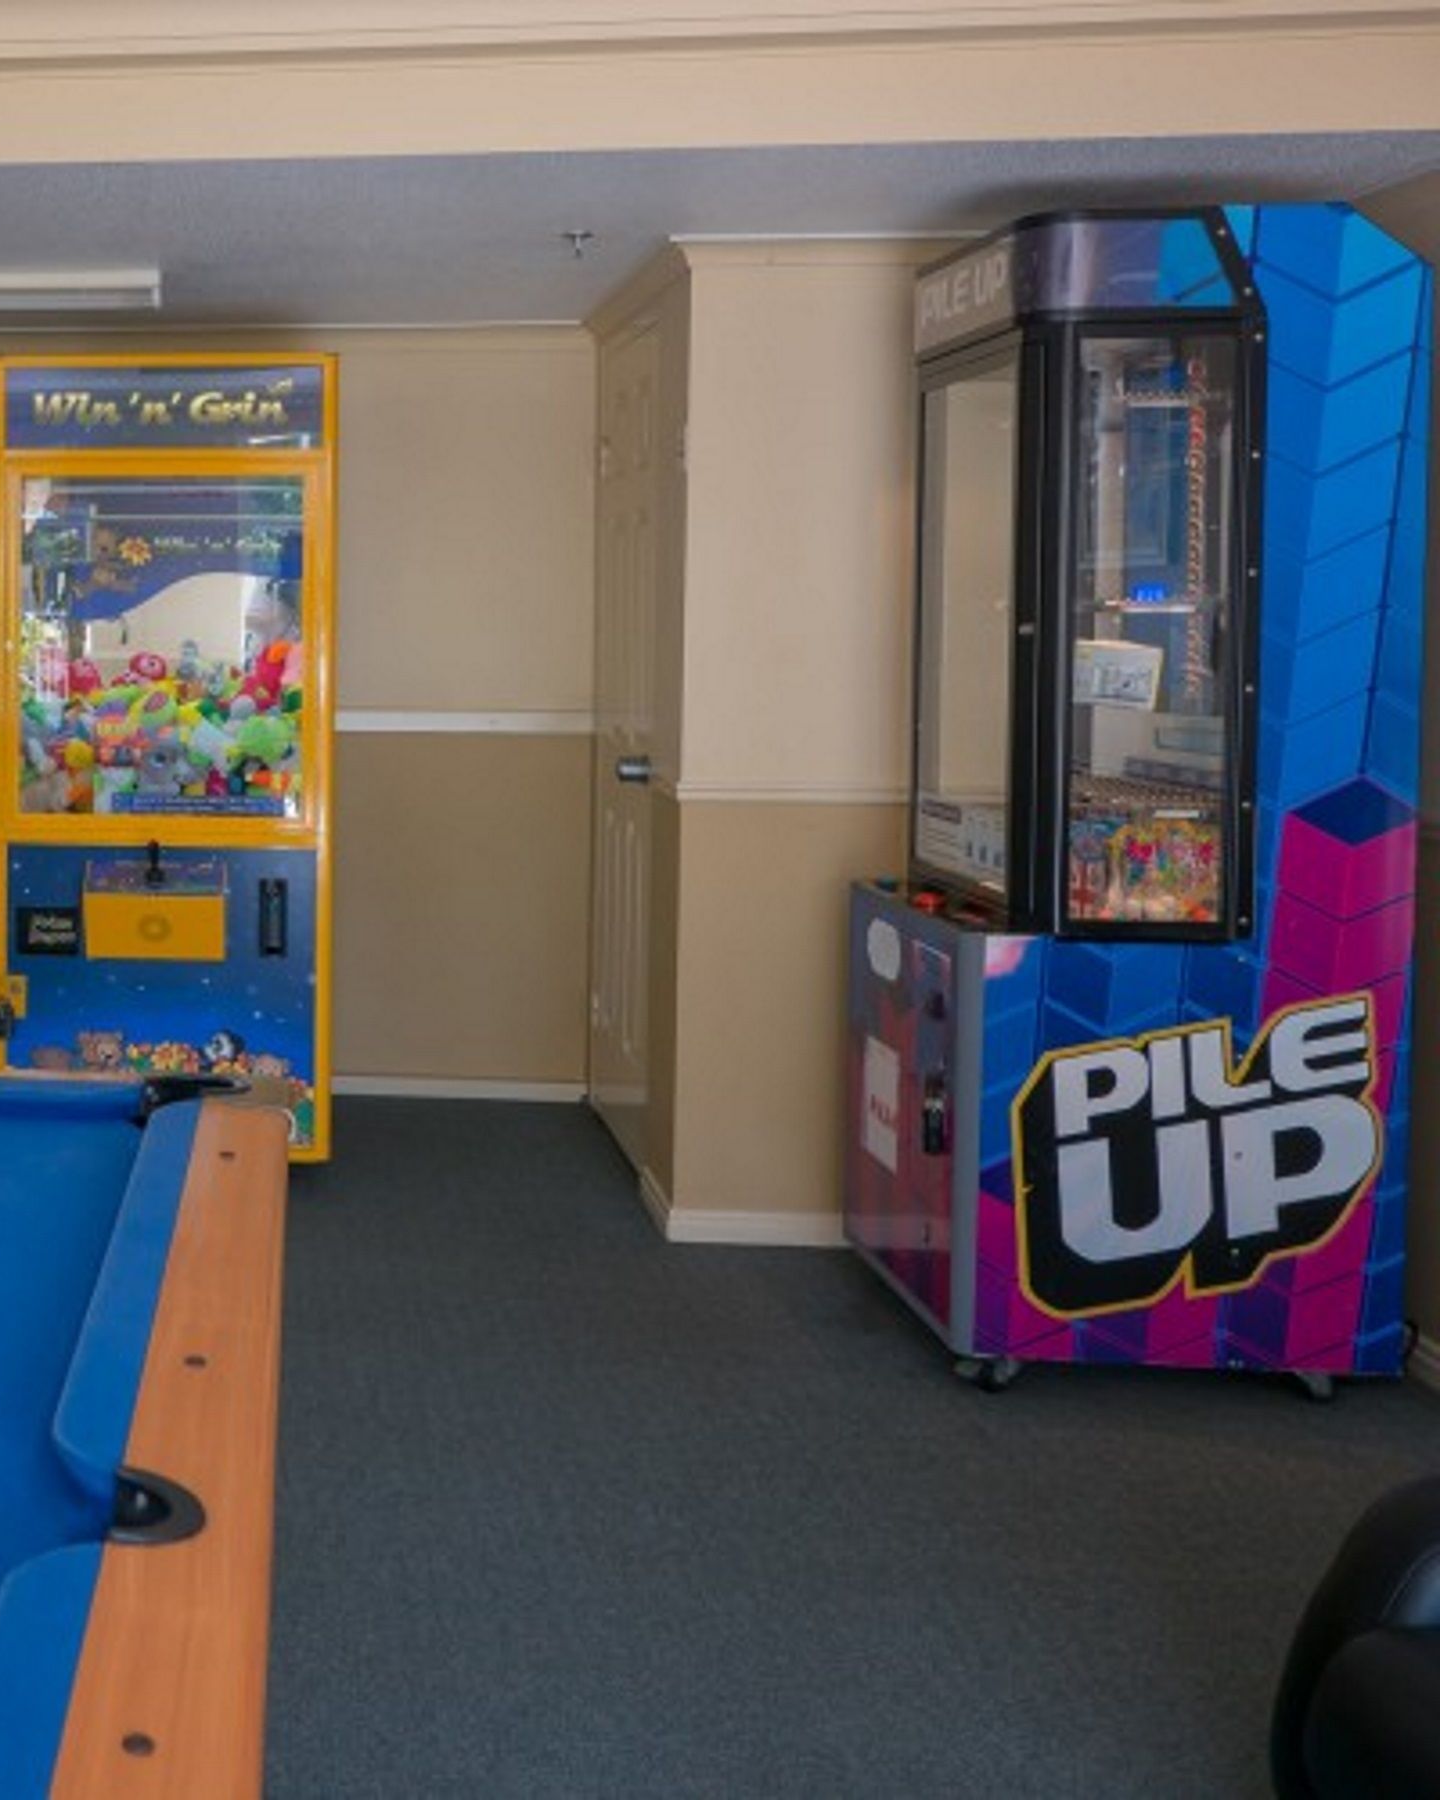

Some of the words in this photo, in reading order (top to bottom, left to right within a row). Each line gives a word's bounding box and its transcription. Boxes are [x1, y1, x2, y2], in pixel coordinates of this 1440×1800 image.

[920, 268, 968, 328] PILE
[974, 250, 1009, 307] UP
[34, 391, 121, 426] Win
[189, 390, 289, 426] Grin
[1054, 999, 1369, 1138] PILE
[1057, 1093, 1376, 1264] UP
